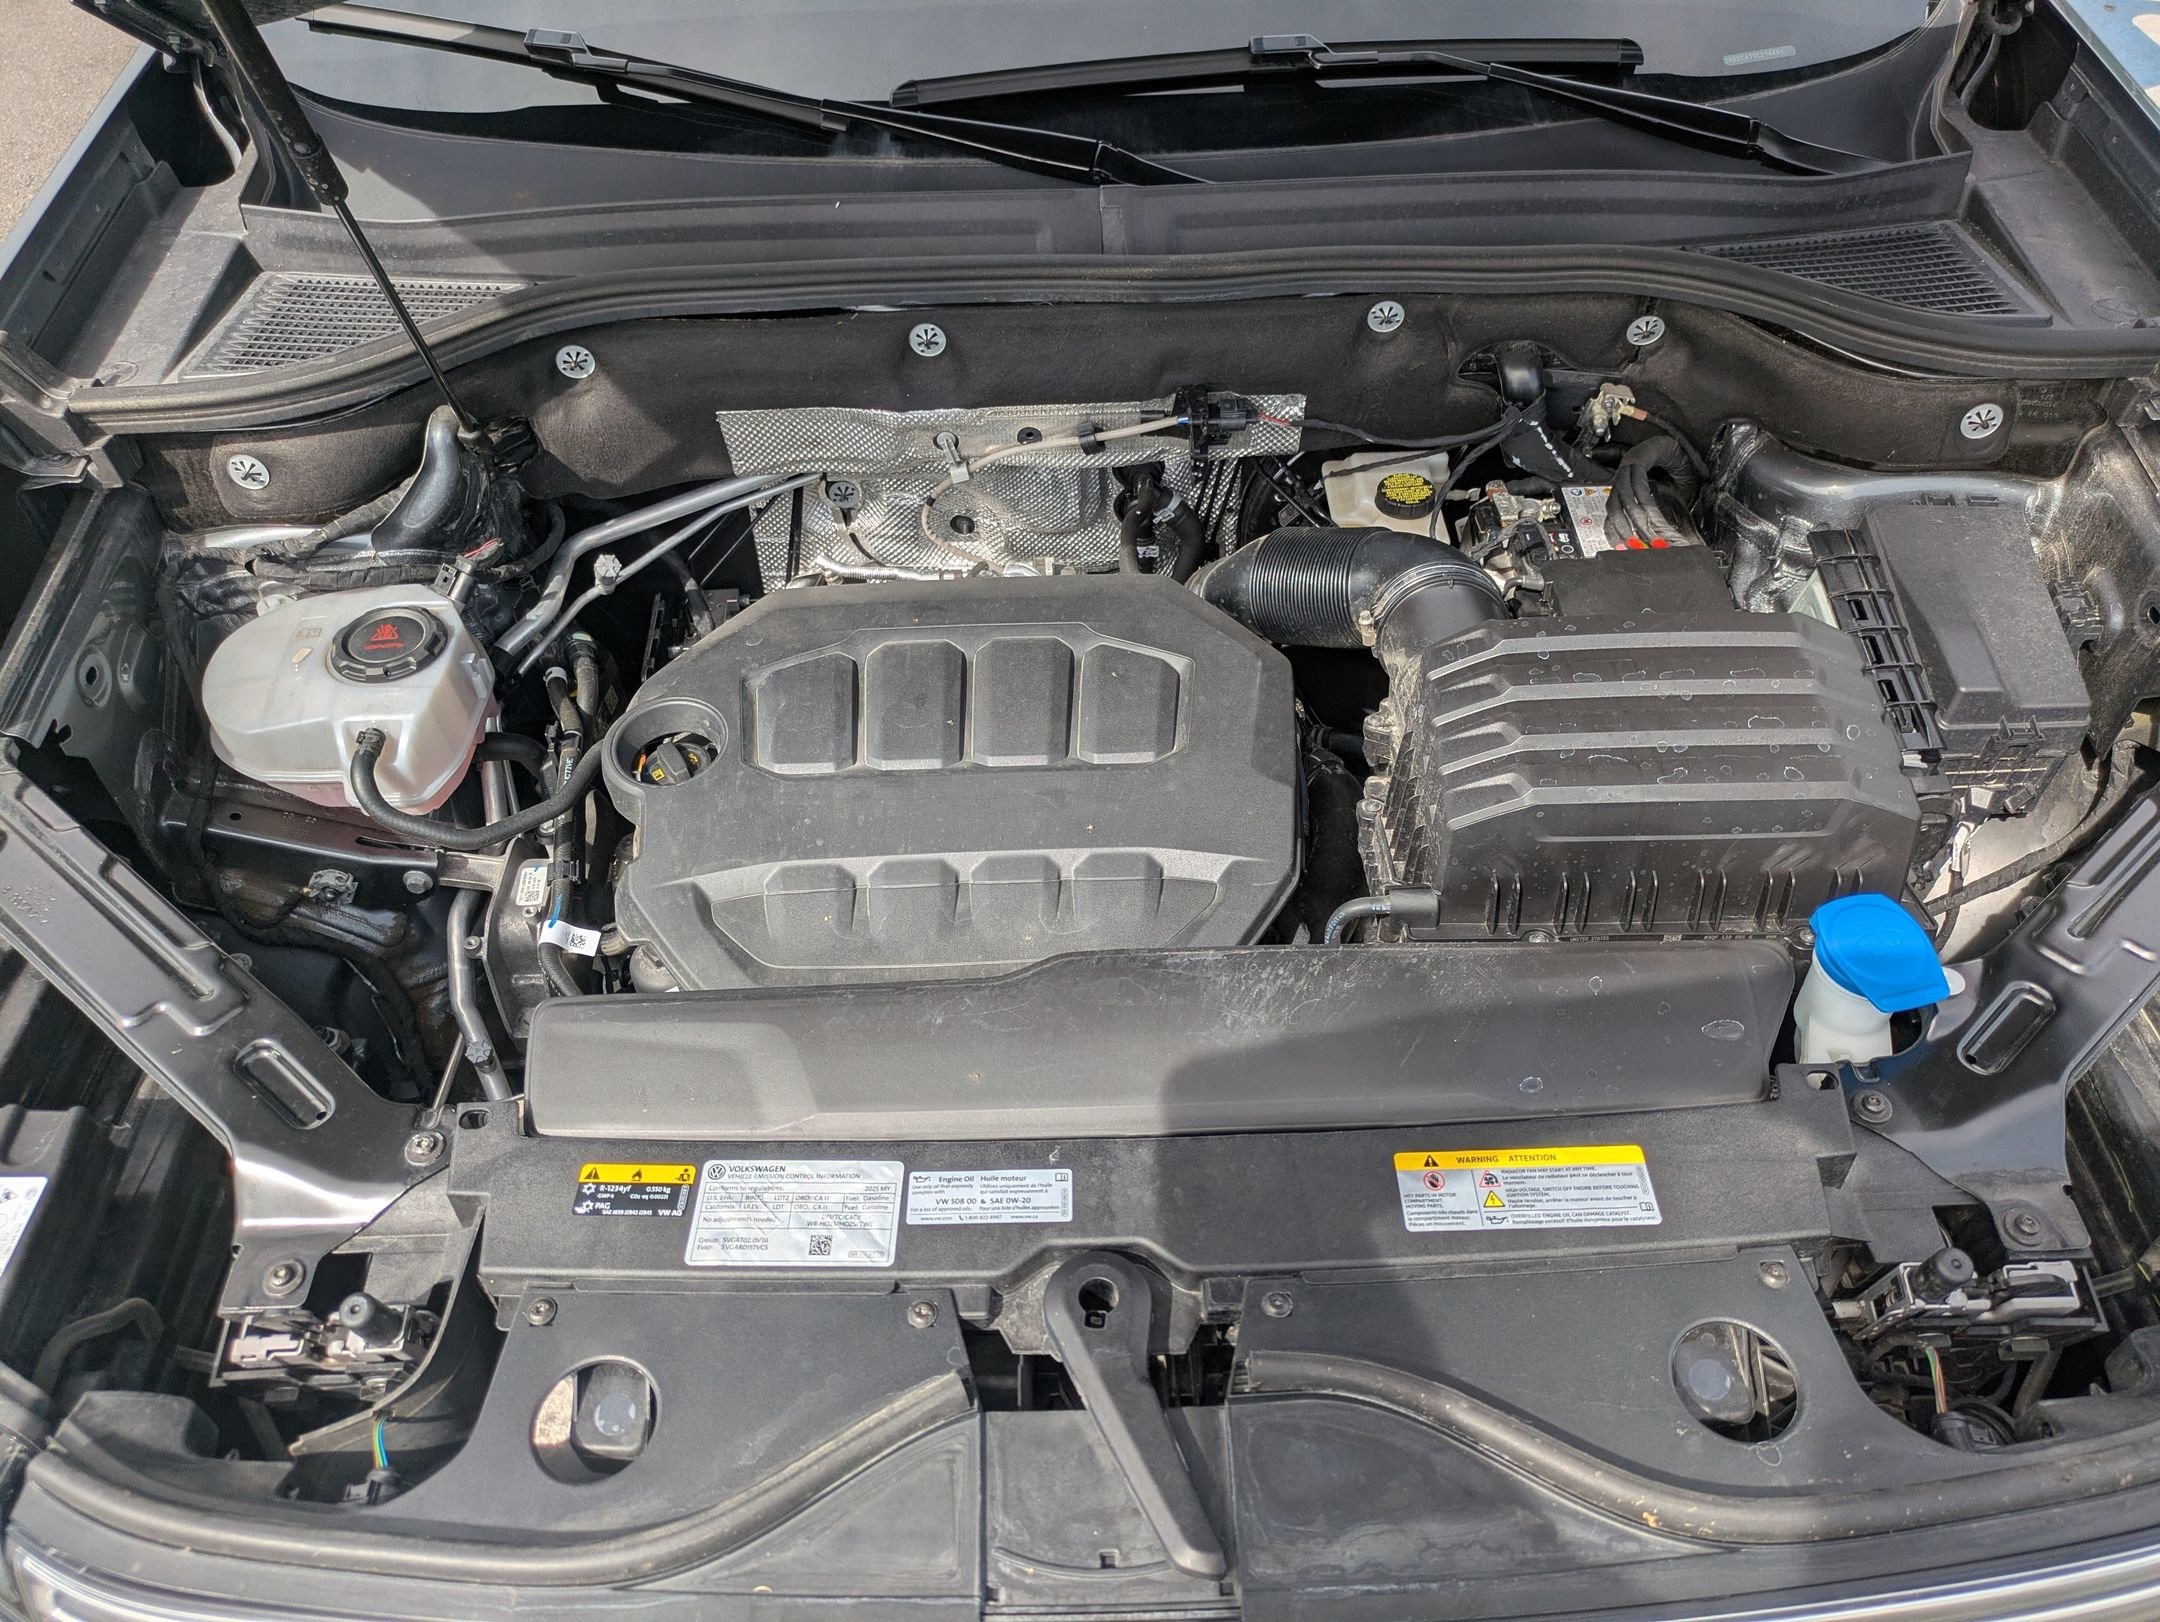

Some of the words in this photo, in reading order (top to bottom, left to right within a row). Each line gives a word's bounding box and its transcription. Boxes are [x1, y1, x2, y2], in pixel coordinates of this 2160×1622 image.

[1456, 1156, 1499, 1164] WARNING
[1509, 1154, 1556, 1162] ATTENTION
[729, 1165, 786, 1173] VOLKSWAGEN
[938, 1176, 962, 1184] Engine
[599, 1184, 632, 1194] R-1234yf
[662, 1186, 671, 1194] kg
